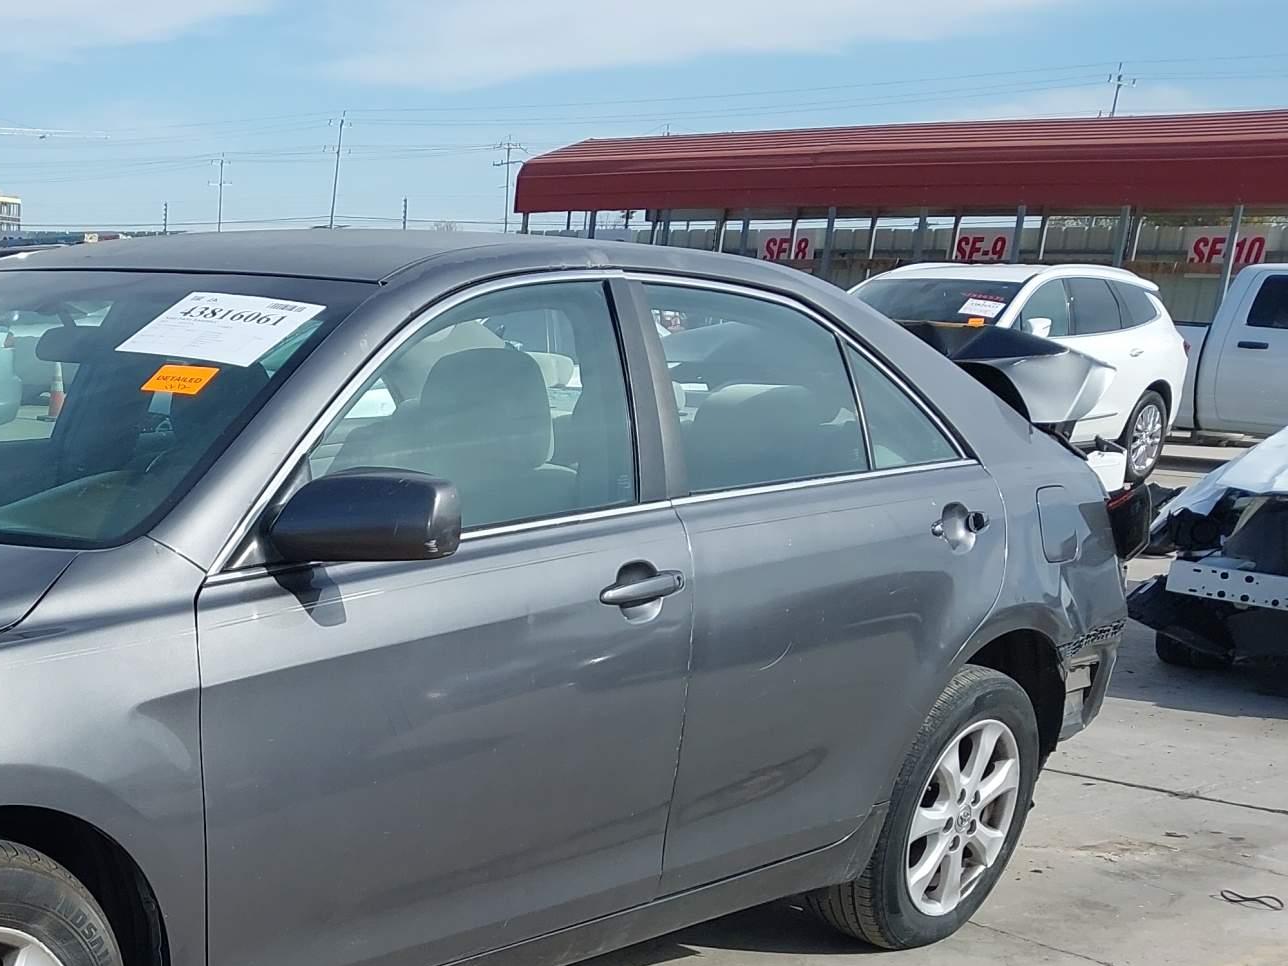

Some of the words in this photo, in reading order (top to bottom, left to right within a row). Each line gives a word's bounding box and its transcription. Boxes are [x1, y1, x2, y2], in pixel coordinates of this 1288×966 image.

[762, 237, 809, 261] SF8
[955, 236, 1007, 261] SF-9
[1189, 236, 1266, 264] SF10
[179, 305, 288, 327] 43816061
[156, 374, 203, 385] DETAILED
